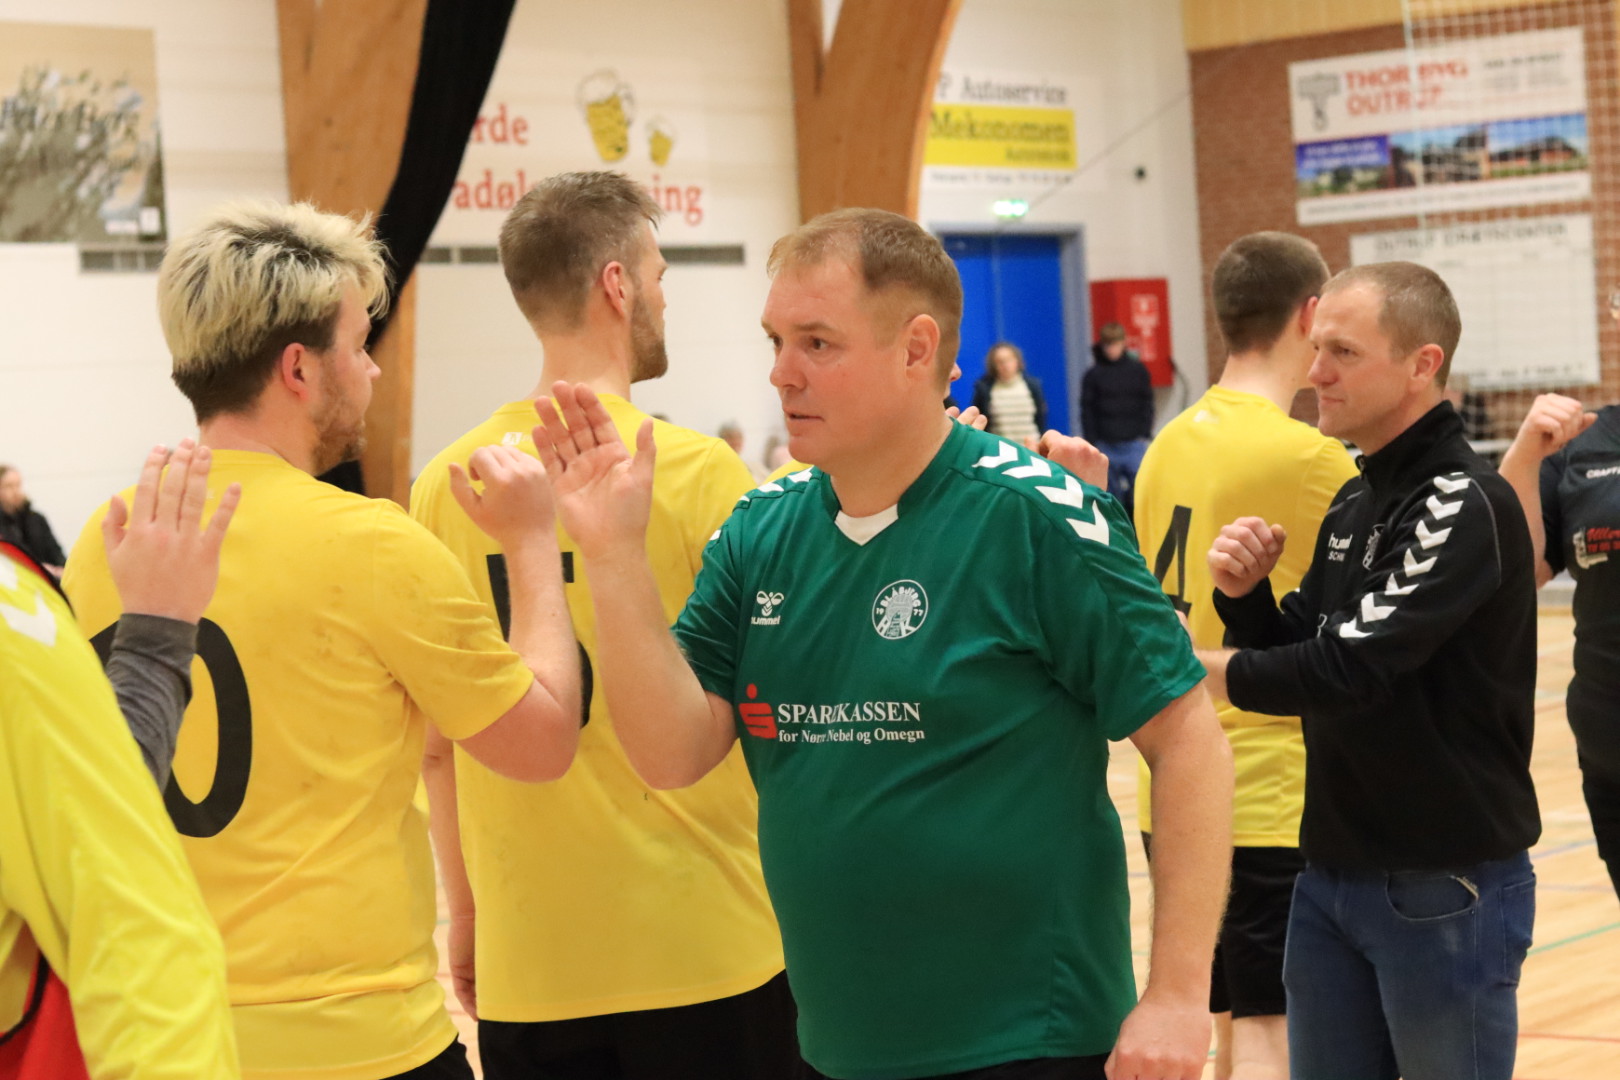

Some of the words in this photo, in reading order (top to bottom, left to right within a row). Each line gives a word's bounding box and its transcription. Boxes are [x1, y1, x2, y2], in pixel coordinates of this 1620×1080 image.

[472, 103, 529, 145] rde
[913, 608, 924, 617] 77
[778, 729, 799, 743] for
[827, 728, 854, 742] Nebel
[856, 730, 871, 745] og
[873, 727, 926, 743] Omegn
